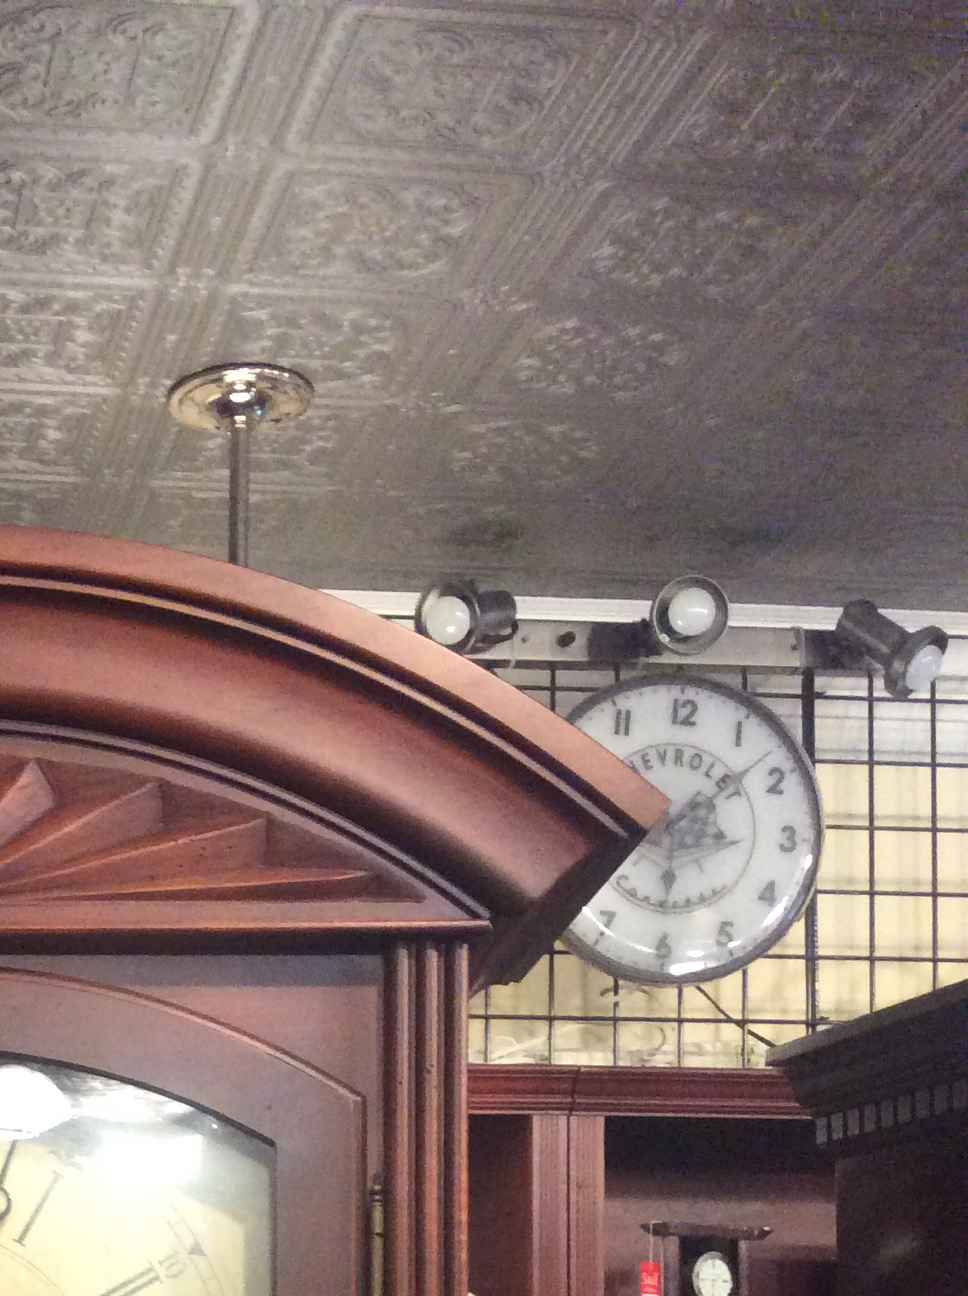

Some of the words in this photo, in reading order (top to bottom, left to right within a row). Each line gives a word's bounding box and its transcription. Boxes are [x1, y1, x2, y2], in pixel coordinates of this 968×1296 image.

[613, 708, 631, 737] 11
[671, 698, 699, 727] 12
[734, 721, 743, 748] 1
[629, 748, 742, 800] EVROLET
[766, 767, 786, 795] 2
[779, 825, 798, 853] 3
[758, 880, 776, 907] 4
[599, 909, 617, 937] 7
[716, 921, 735, 947] 5
[655, 932, 673, 959] 6
